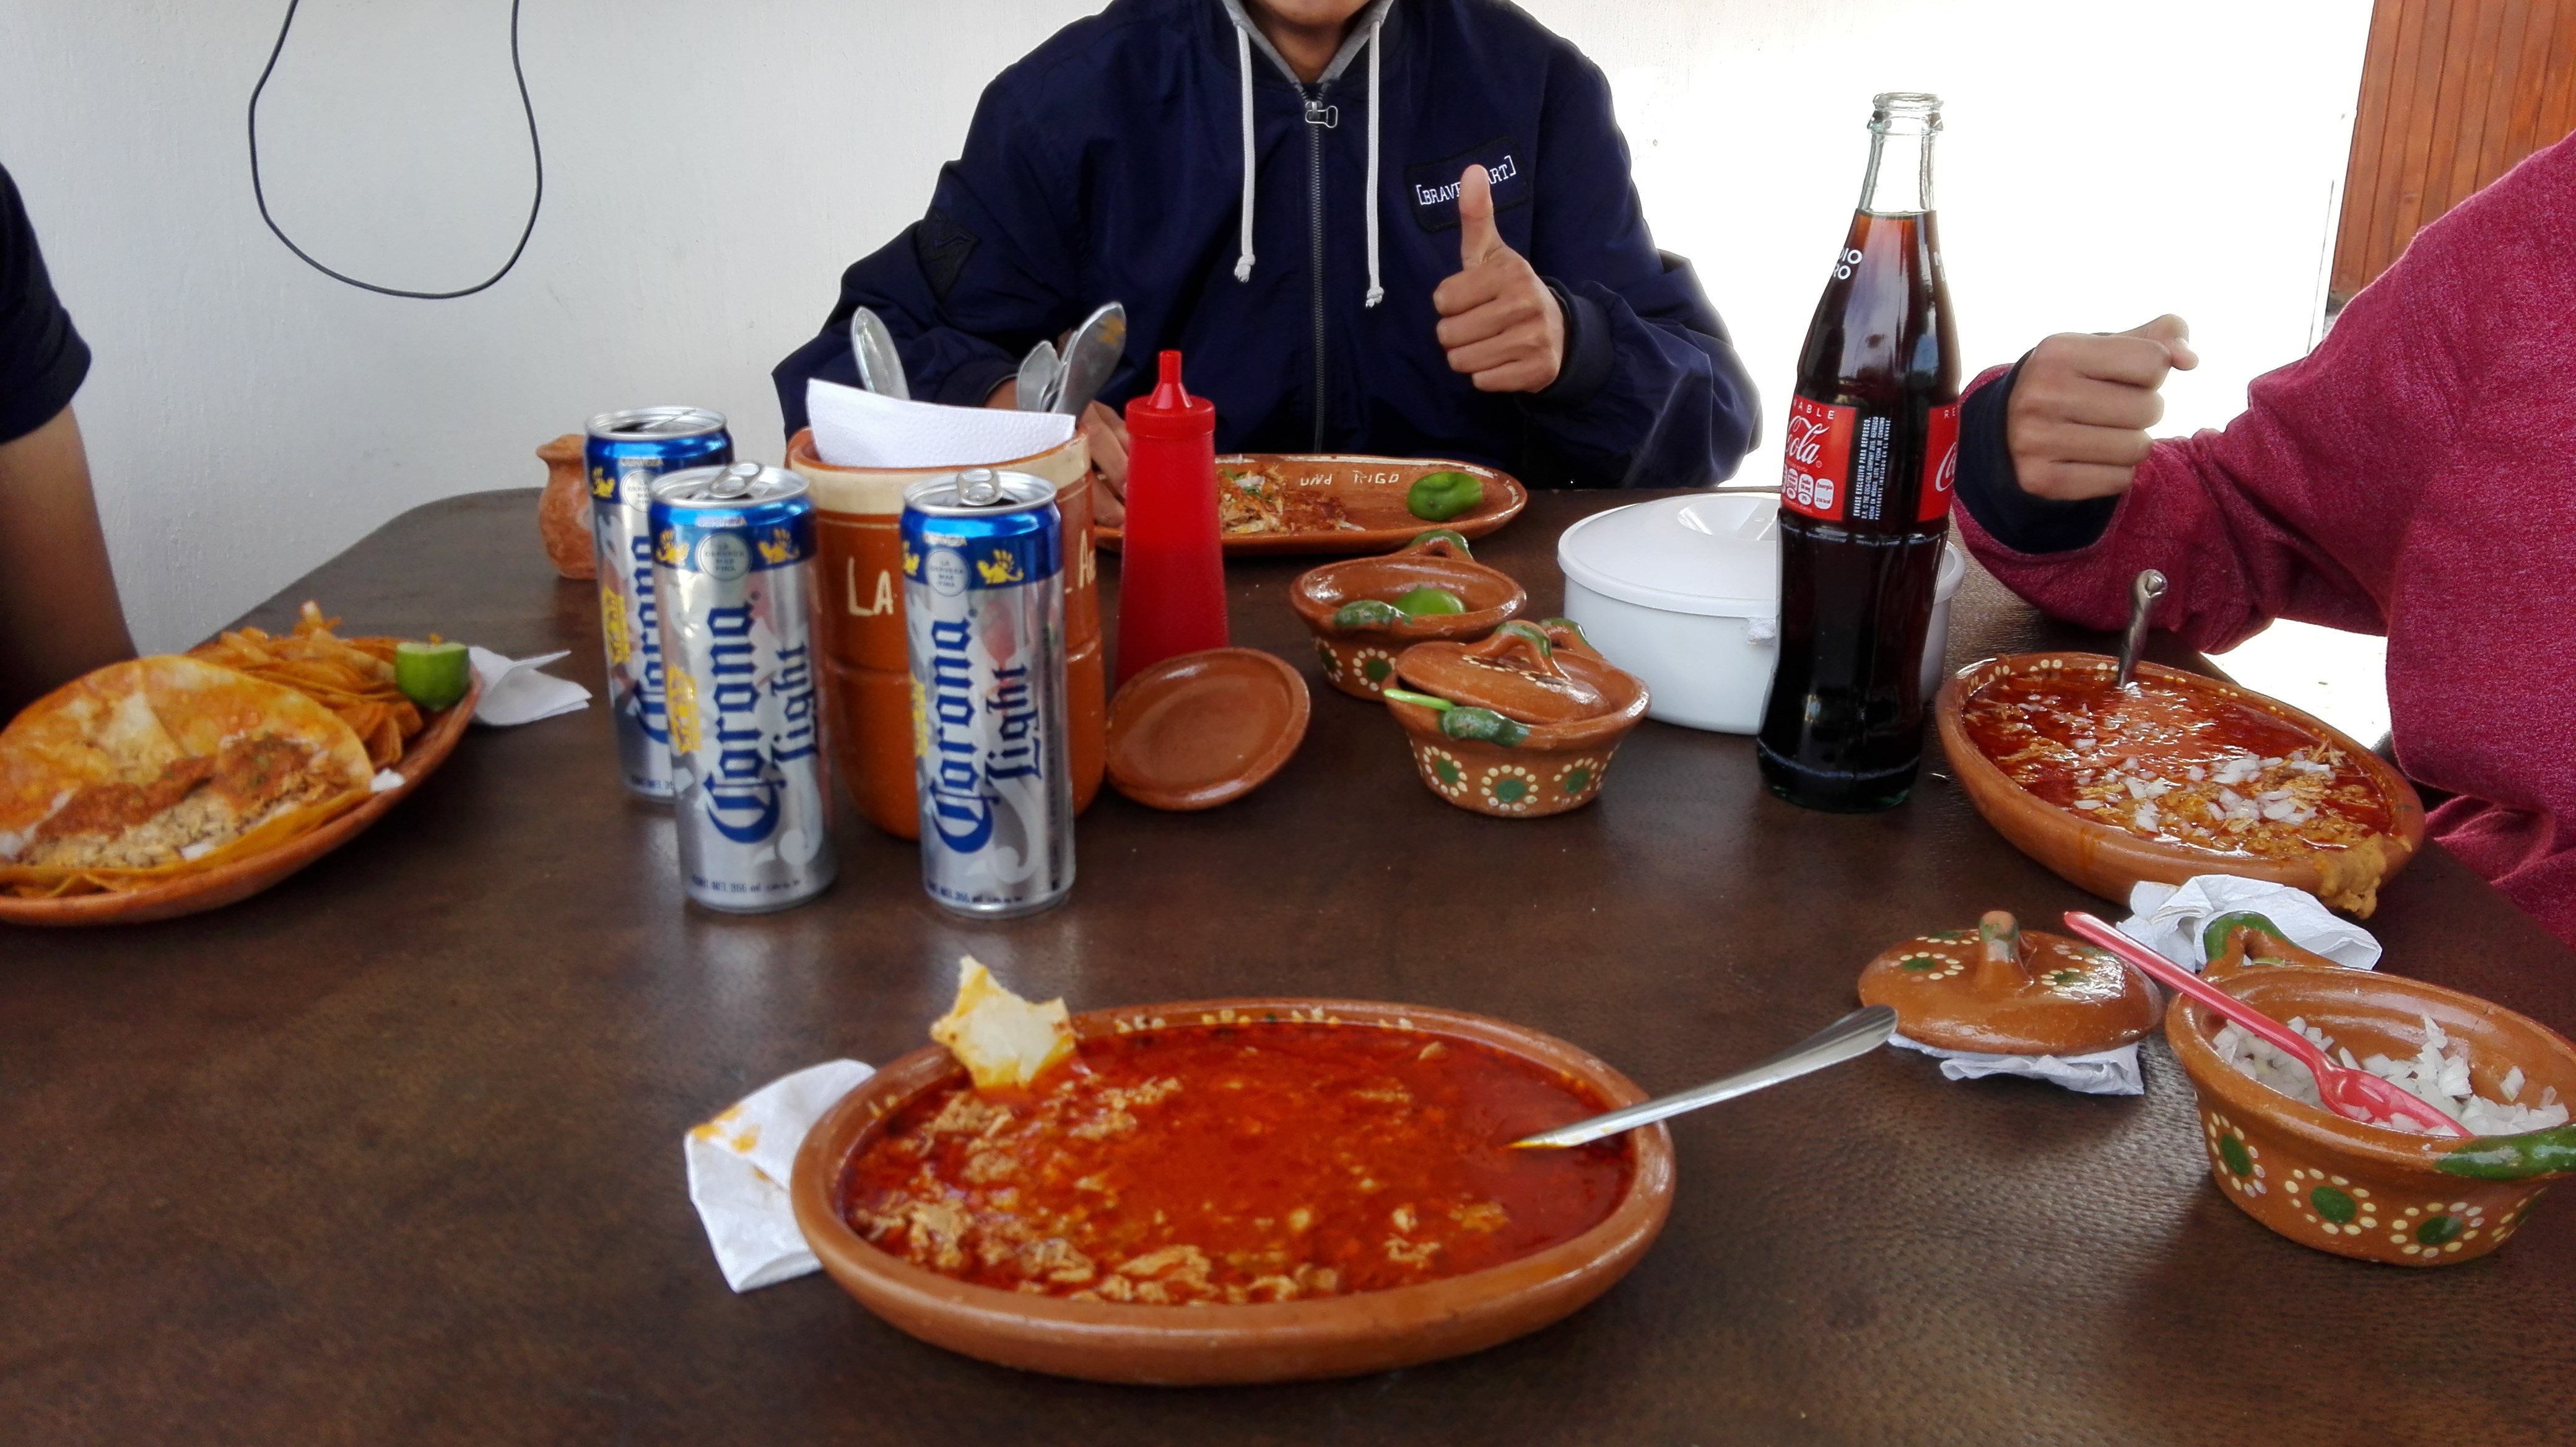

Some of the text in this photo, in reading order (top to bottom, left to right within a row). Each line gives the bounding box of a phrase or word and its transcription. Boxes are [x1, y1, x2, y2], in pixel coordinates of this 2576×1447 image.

[1853, 496, 1861, 516] ENVASE
[1856, 465, 1865, 494] EXCLUSIVO
[1875, 488, 1883, 520] PREFERENTE
[703, 601, 786, 843] Corona
[771, 642, 818, 771] Light
[928, 617, 999, 854] Corona
[985, 663, 1042, 781] Light
